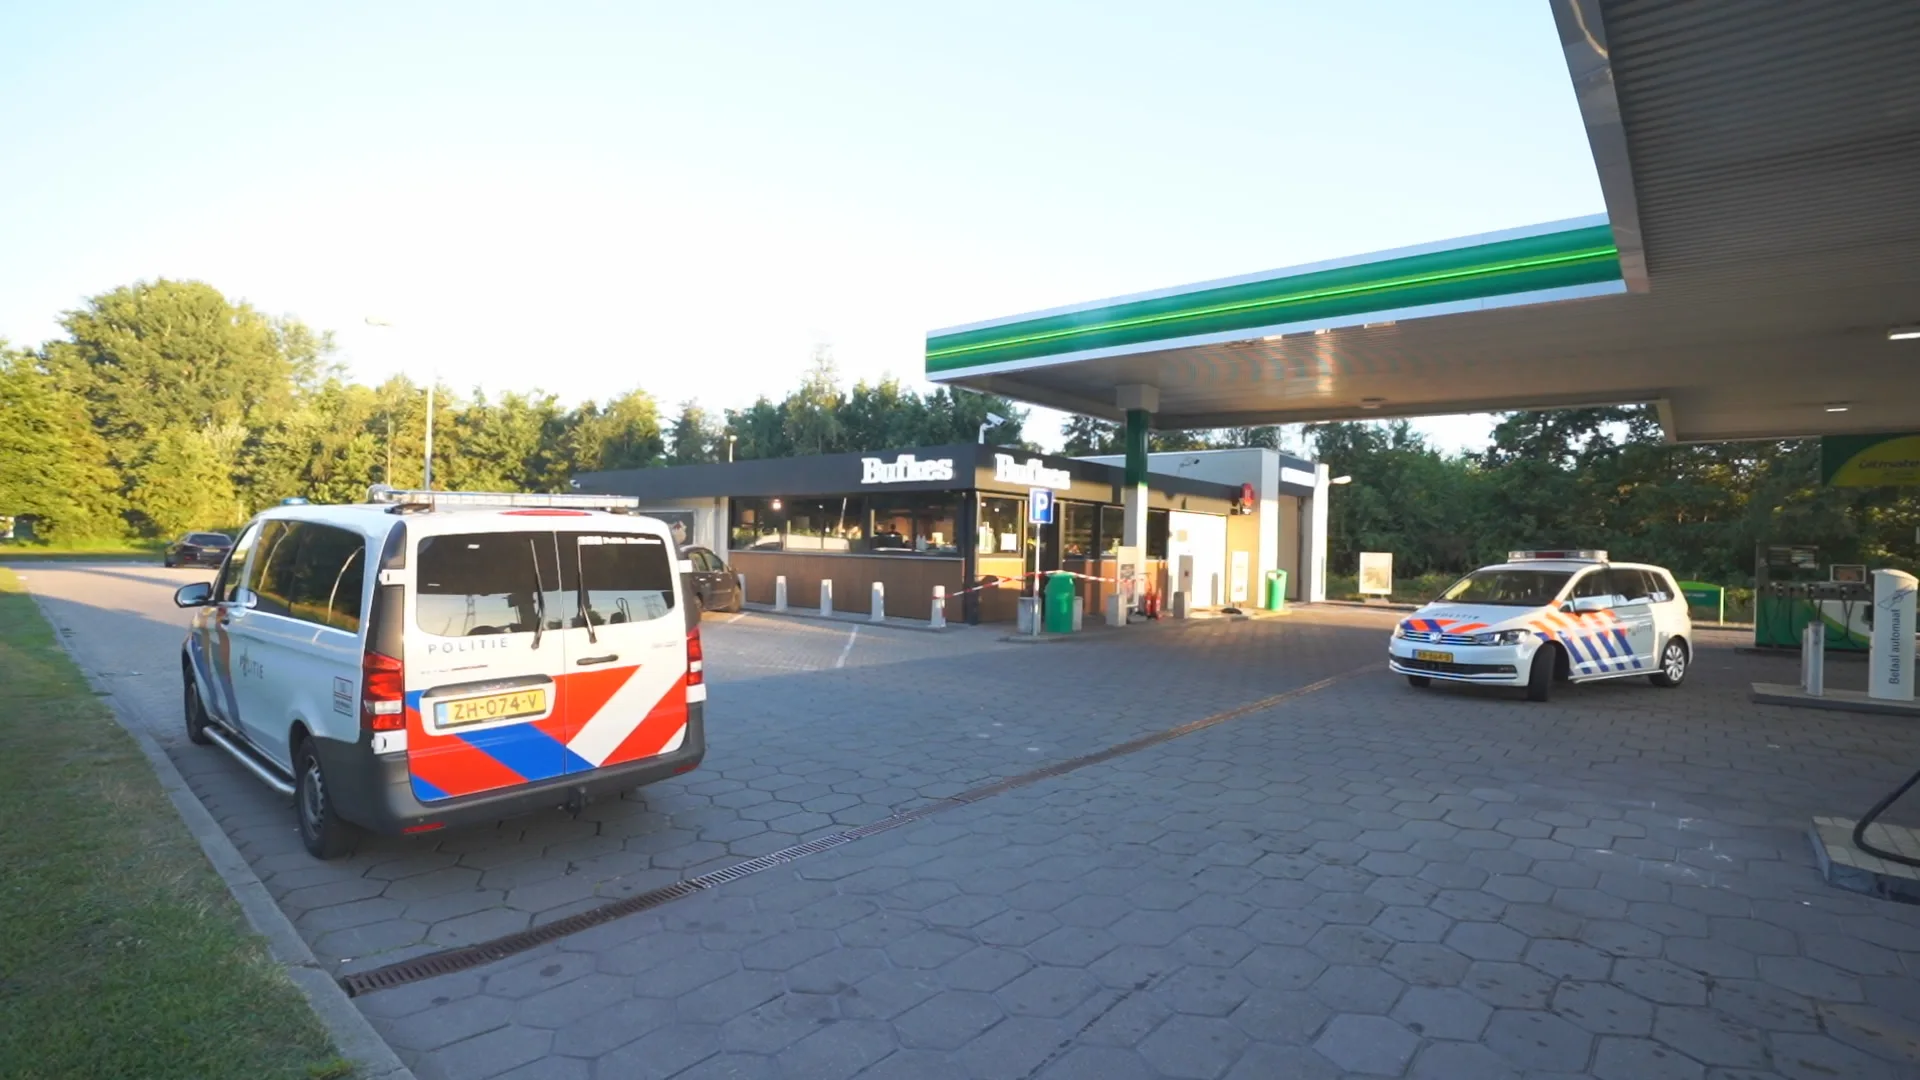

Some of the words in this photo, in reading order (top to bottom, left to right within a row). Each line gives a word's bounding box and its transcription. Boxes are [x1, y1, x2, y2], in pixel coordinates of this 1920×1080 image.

[861, 454, 953, 484] Bufkes
[1034, 492, 1049, 520] P
[1890, 608, 1901, 652] automaat
[428, 638, 508, 655] POLITIE
[1889, 655, 1900, 685] Betaal
[454, 693, 538, 720] ZH-074-V
